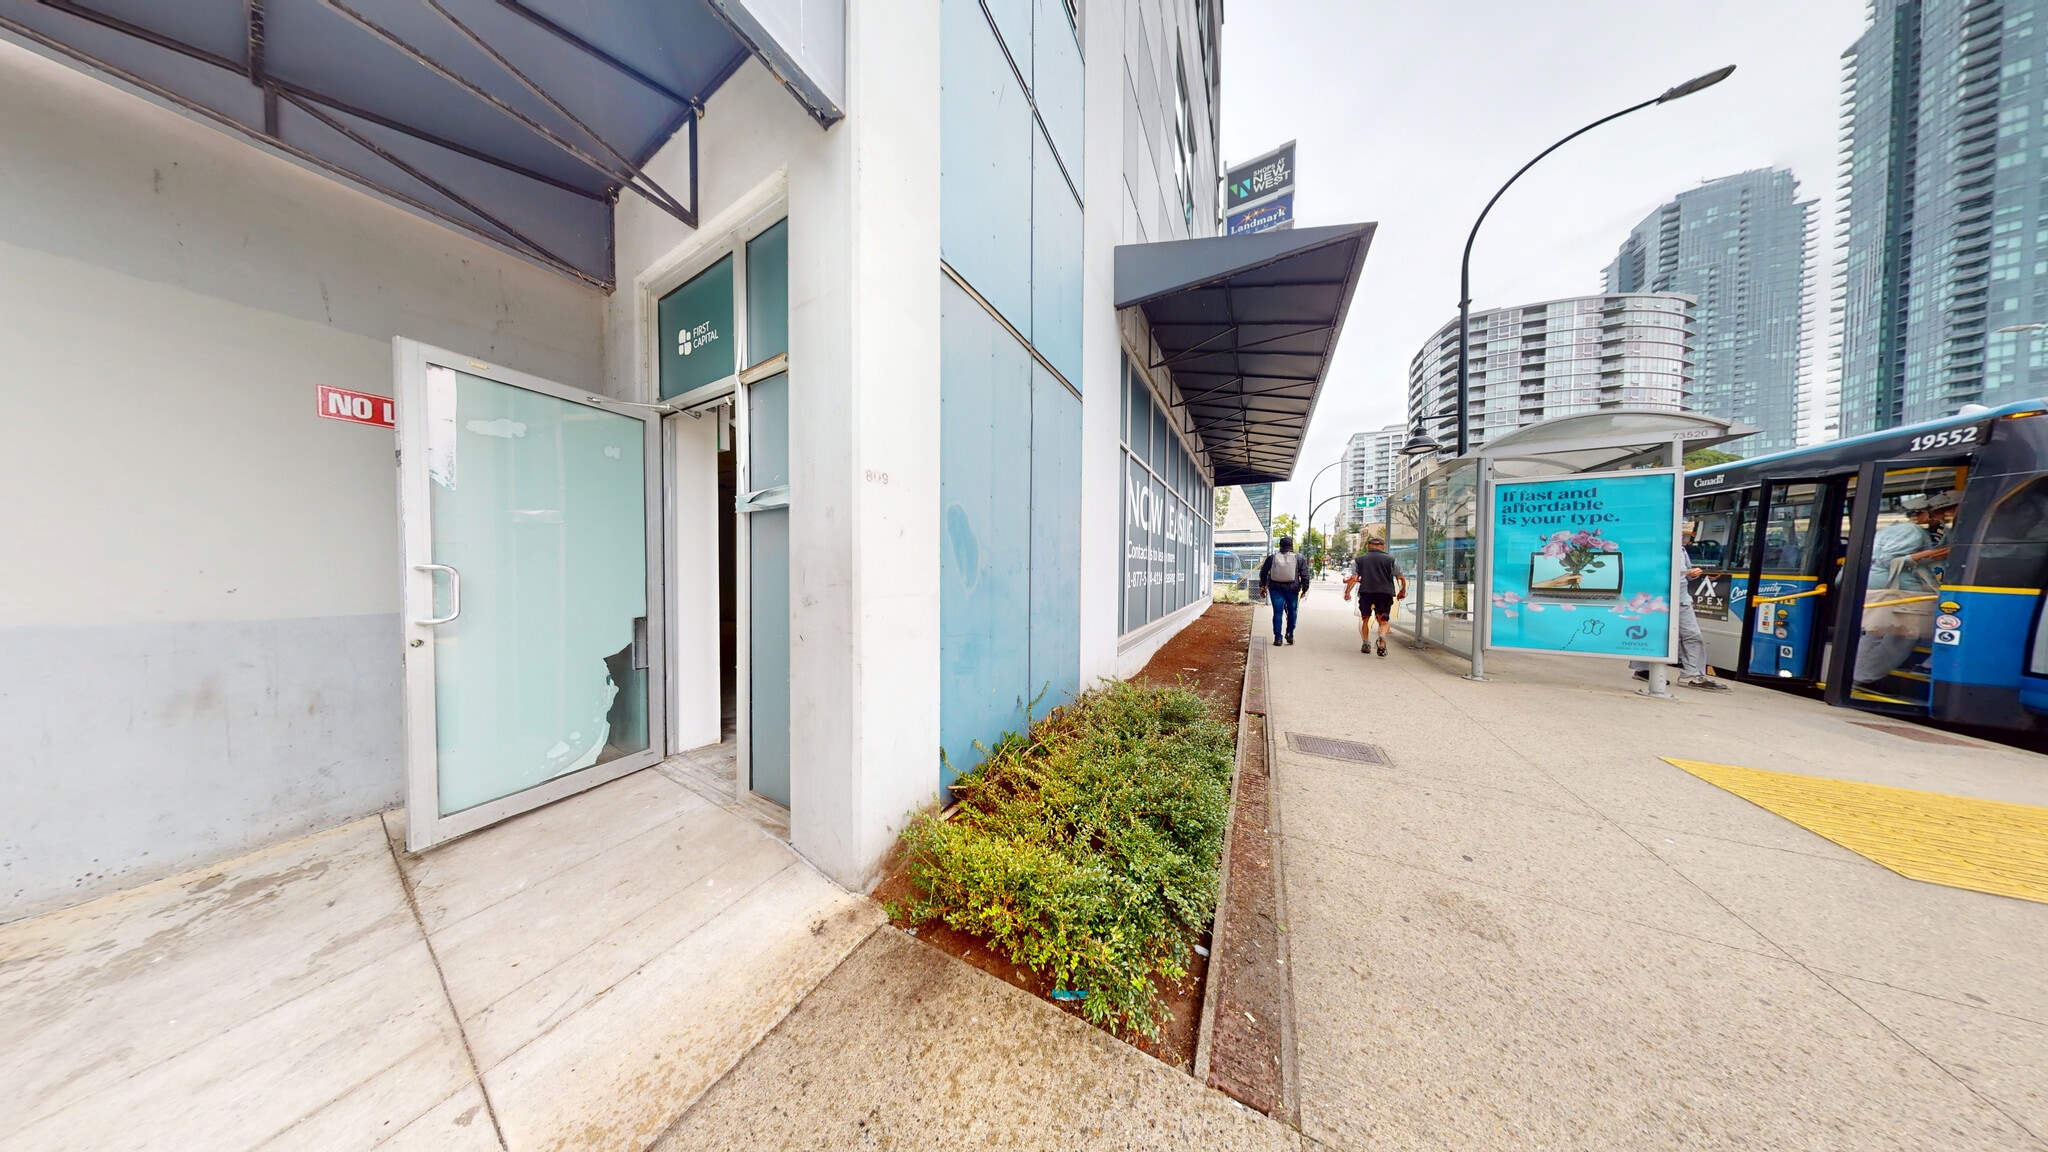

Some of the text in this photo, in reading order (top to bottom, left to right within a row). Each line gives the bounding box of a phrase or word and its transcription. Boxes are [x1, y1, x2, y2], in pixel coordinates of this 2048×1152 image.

[1253, 157, 1285, 176] SHOPS AT
[1253, 163, 1285, 185] NEW
[1253, 170, 1291, 192] WEST
[1231, 208, 1285, 235] Landmark
[693, 320, 710, 338] FIRST
[693, 329, 719, 349] CAPITAL
[328, 391, 373, 420] NO
[1672, 430, 1708, 439] 73520
[1910, 426, 1978, 452] 19552
[1693, 474, 1725, 488] Canada
[1503, 487, 1597, 502] If fast and
[1129, 474, 1193, 547] NOW EASIG
[1502, 500, 1604, 514] affordable
[1502, 512, 1620, 527] is your type.
